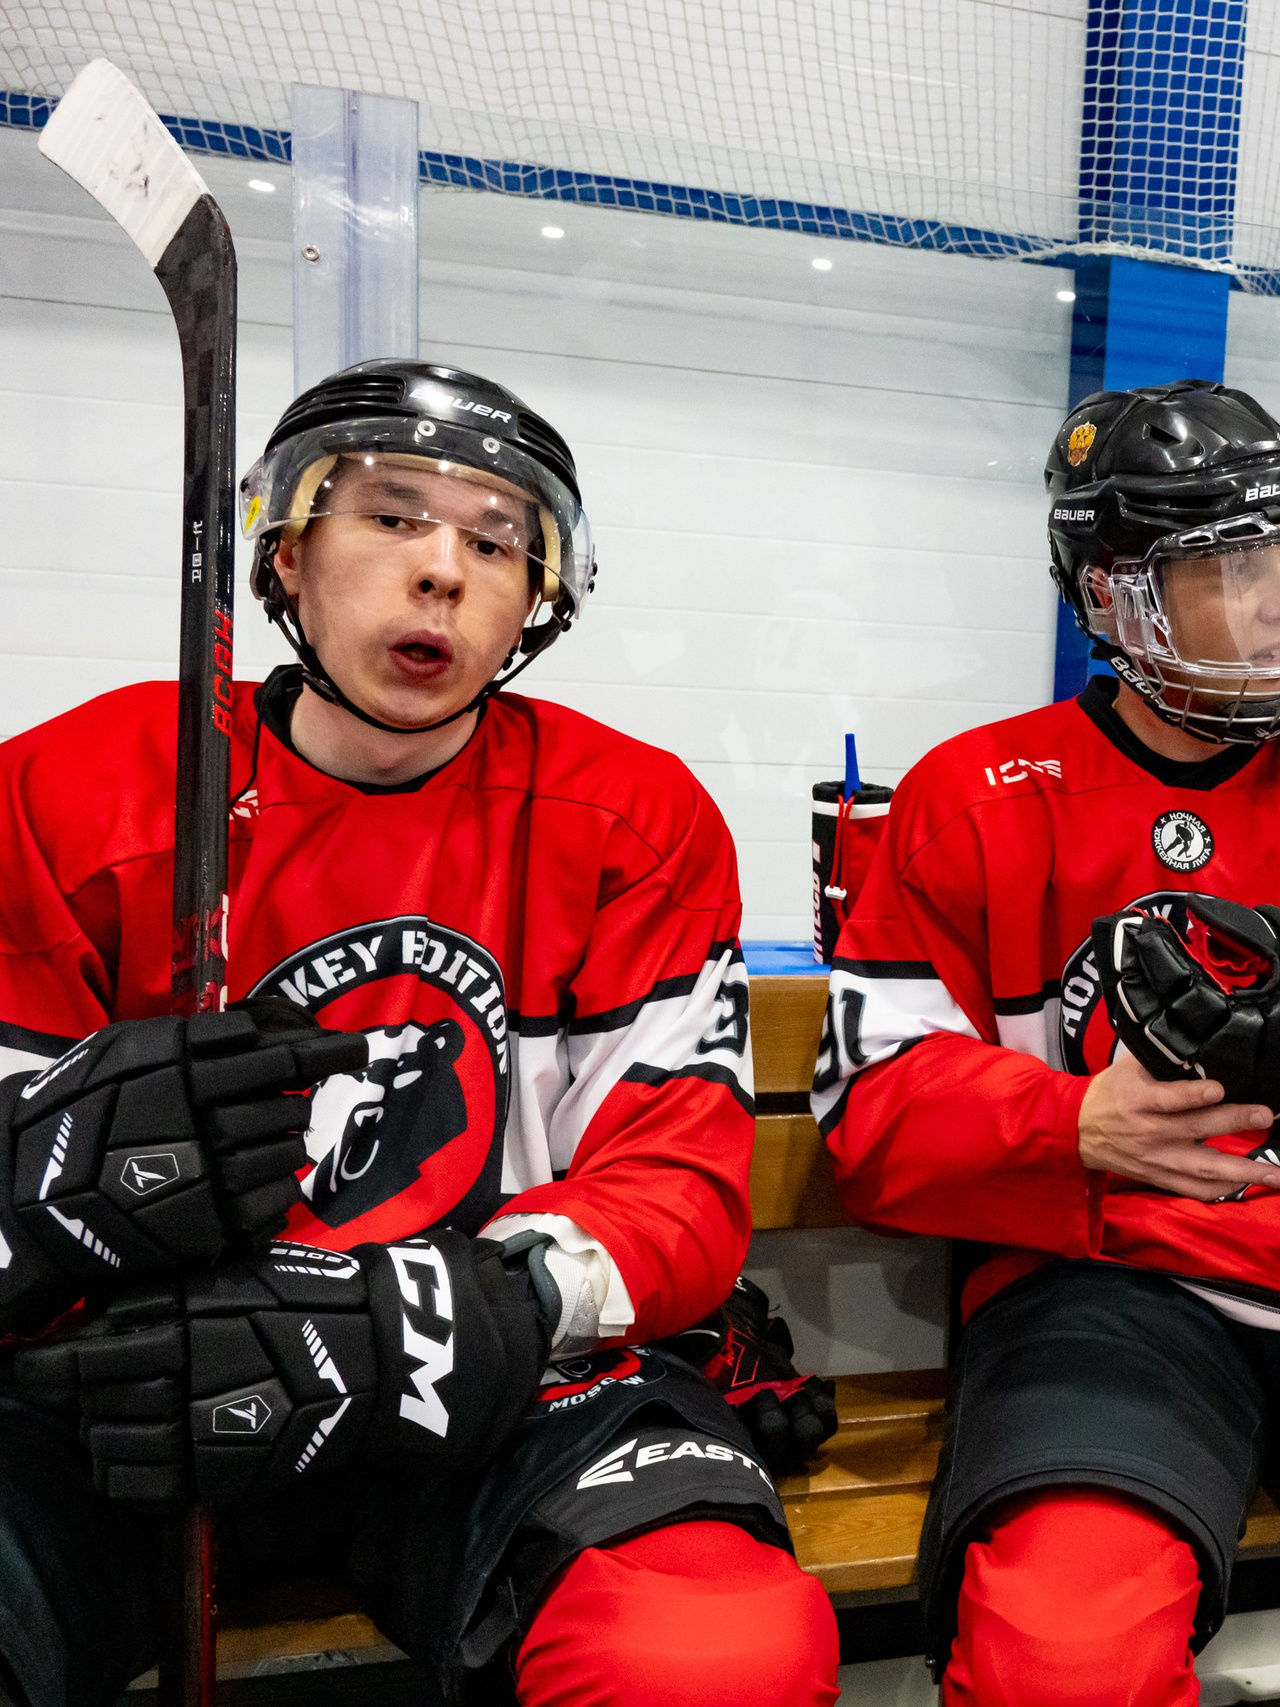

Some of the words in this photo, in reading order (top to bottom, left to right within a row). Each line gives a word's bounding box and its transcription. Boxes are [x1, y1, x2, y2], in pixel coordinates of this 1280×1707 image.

[1053, 508, 1096, 522] BAUER
[1168, 811, 1207, 833] НОЧНАЯ
[1153, 826, 1190, 870] ХОККЕЙНАЯ
[1192, 848, 1212, 868] ЛИГА
[387, 1238, 454, 1438] CM
